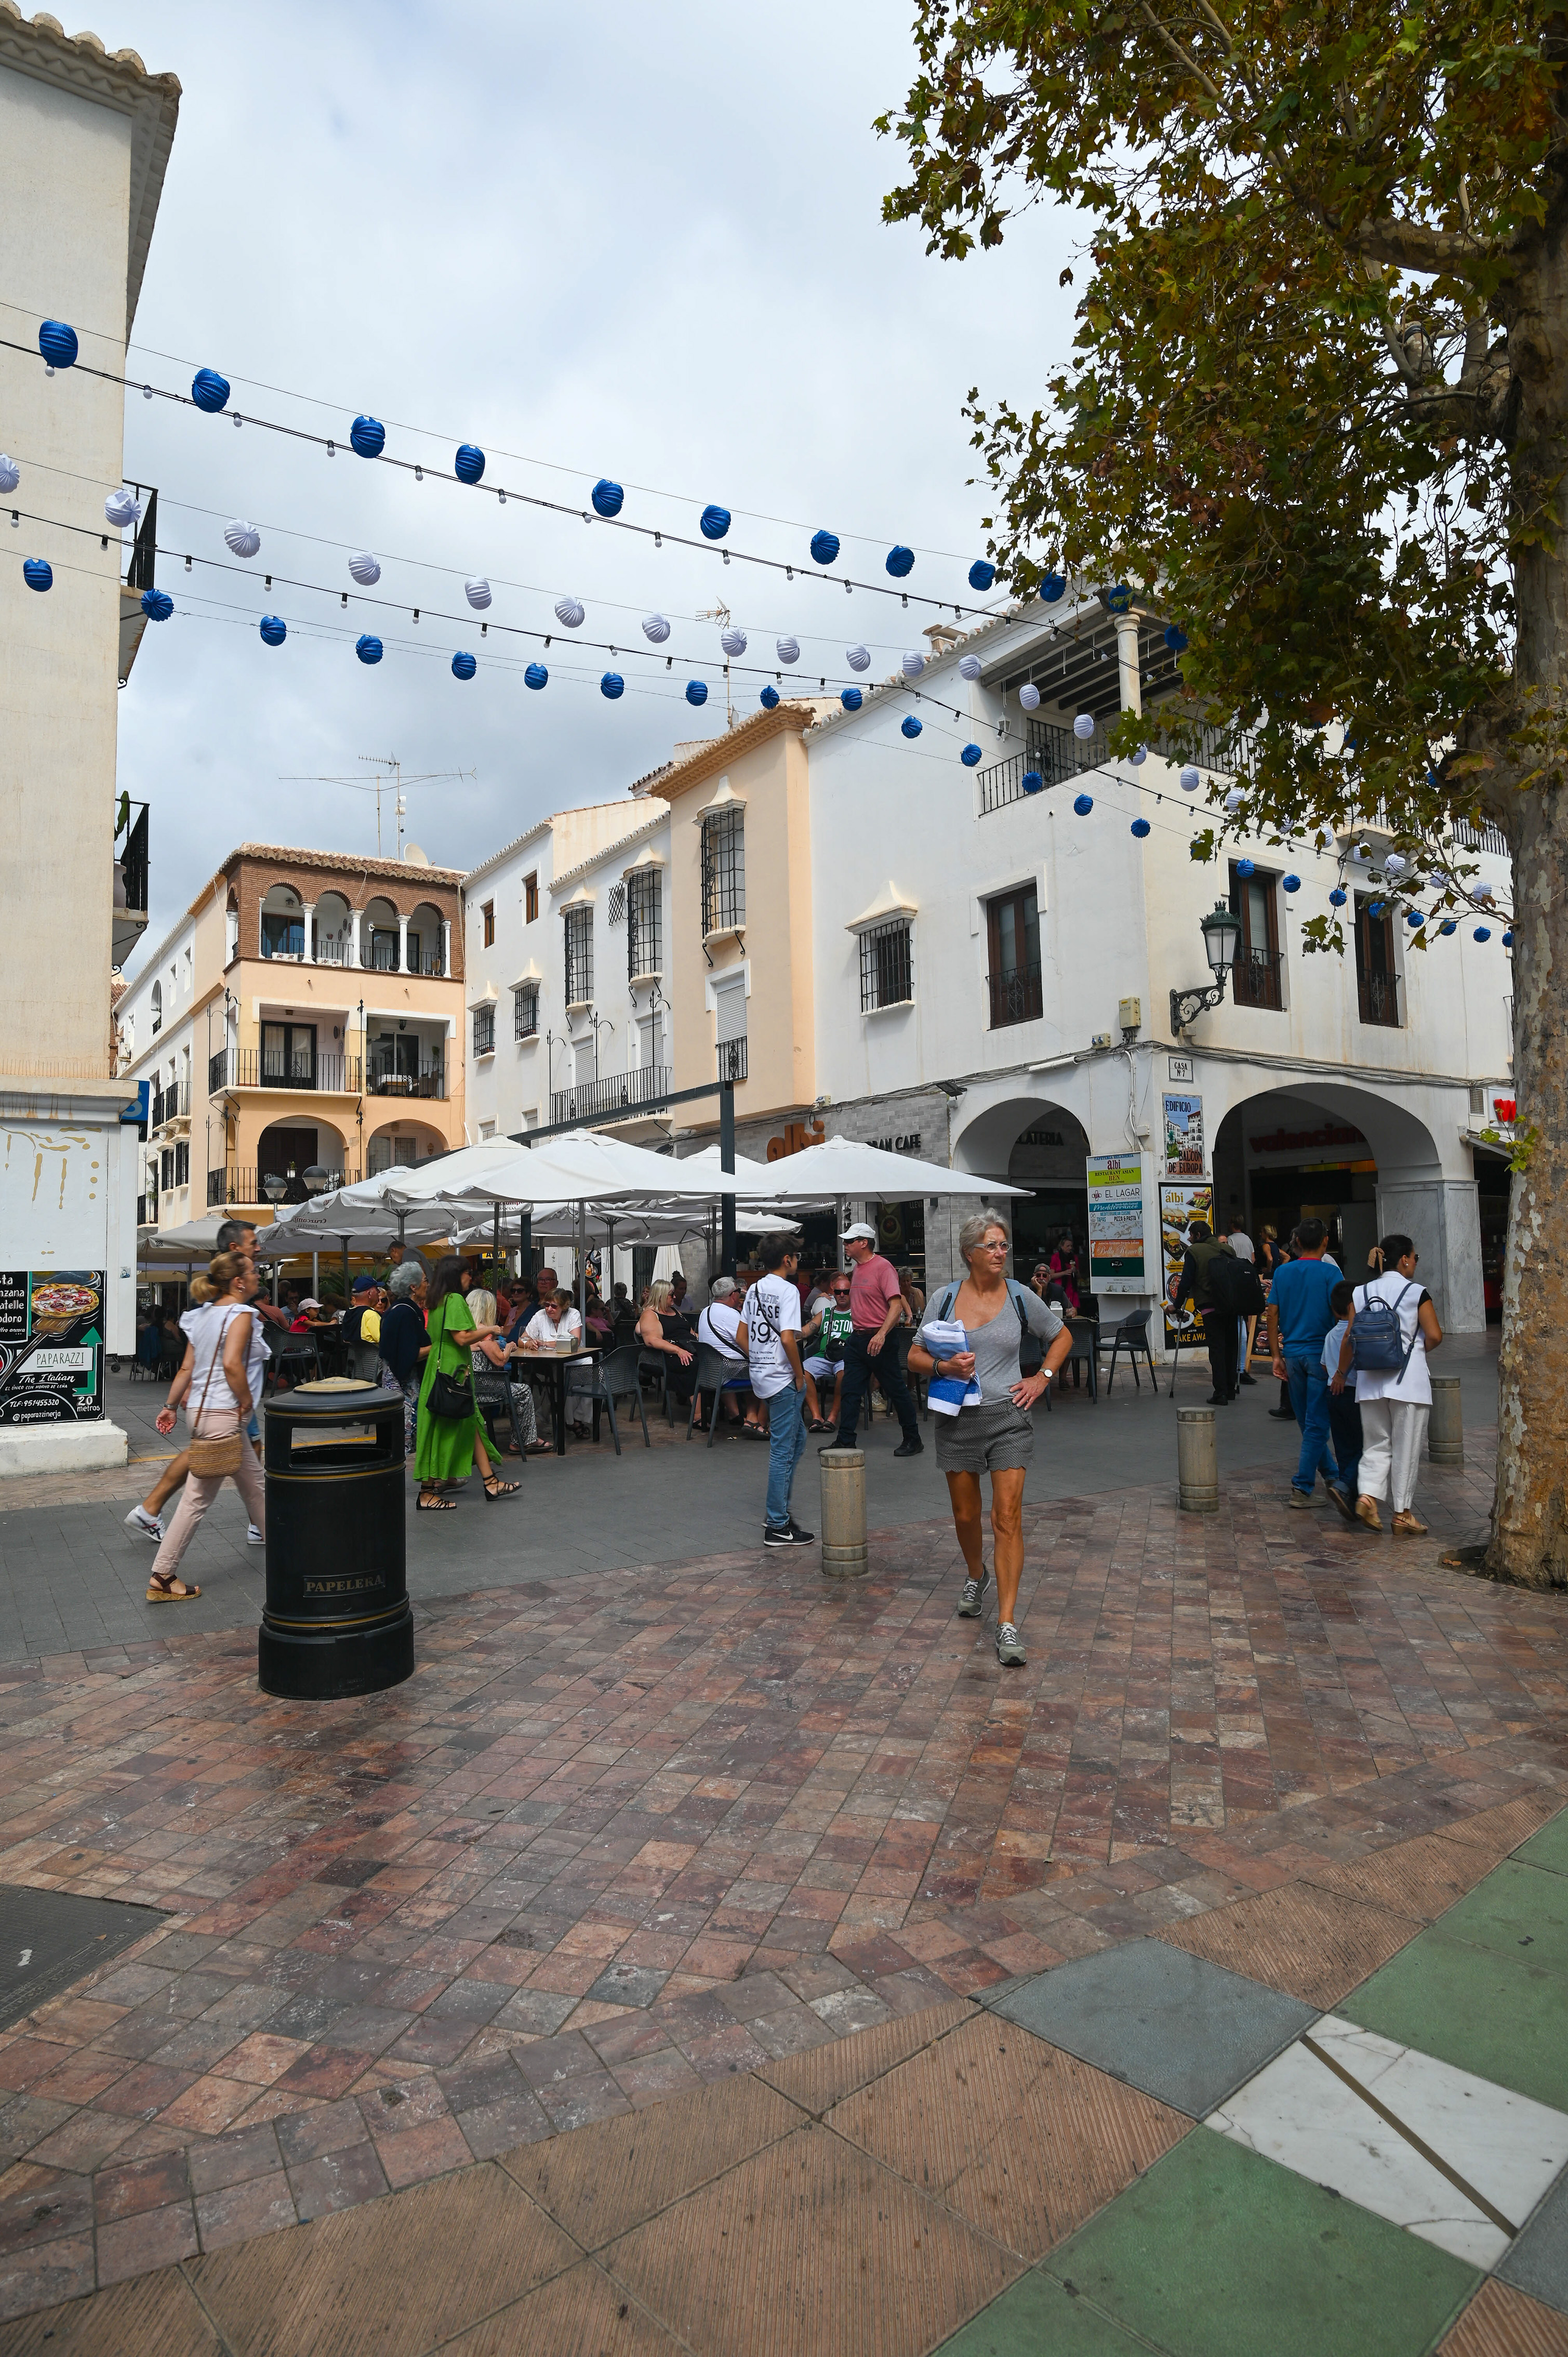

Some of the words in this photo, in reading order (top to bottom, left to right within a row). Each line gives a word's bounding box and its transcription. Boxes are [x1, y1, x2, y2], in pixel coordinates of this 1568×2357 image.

[1174, 1062, 1188, 1070] CASA
[1165, 1101, 1191, 1113] EDIFICIO
[895, 1134, 921, 1150] CAFE
[1107, 1159, 1121, 1170] albi
[1168, 1162, 1177, 1173] DE
[1179, 1162, 1203, 1174] EUROPA
[1116, 1188, 1140, 1197] LAGAR
[1165, 1192, 1184, 1203] albi
[750, 1320, 770, 1344] 59
[1174, 1334, 1191, 1343] TAKE
[37, 1352, 84, 1365] PAPARAZZI
[19, 1374, 35, 1384] The
[39, 1373, 75, 1383] Italian
[78, 1396, 93, 1406] 20
[306, 1574, 383, 1592] PAPELERA
